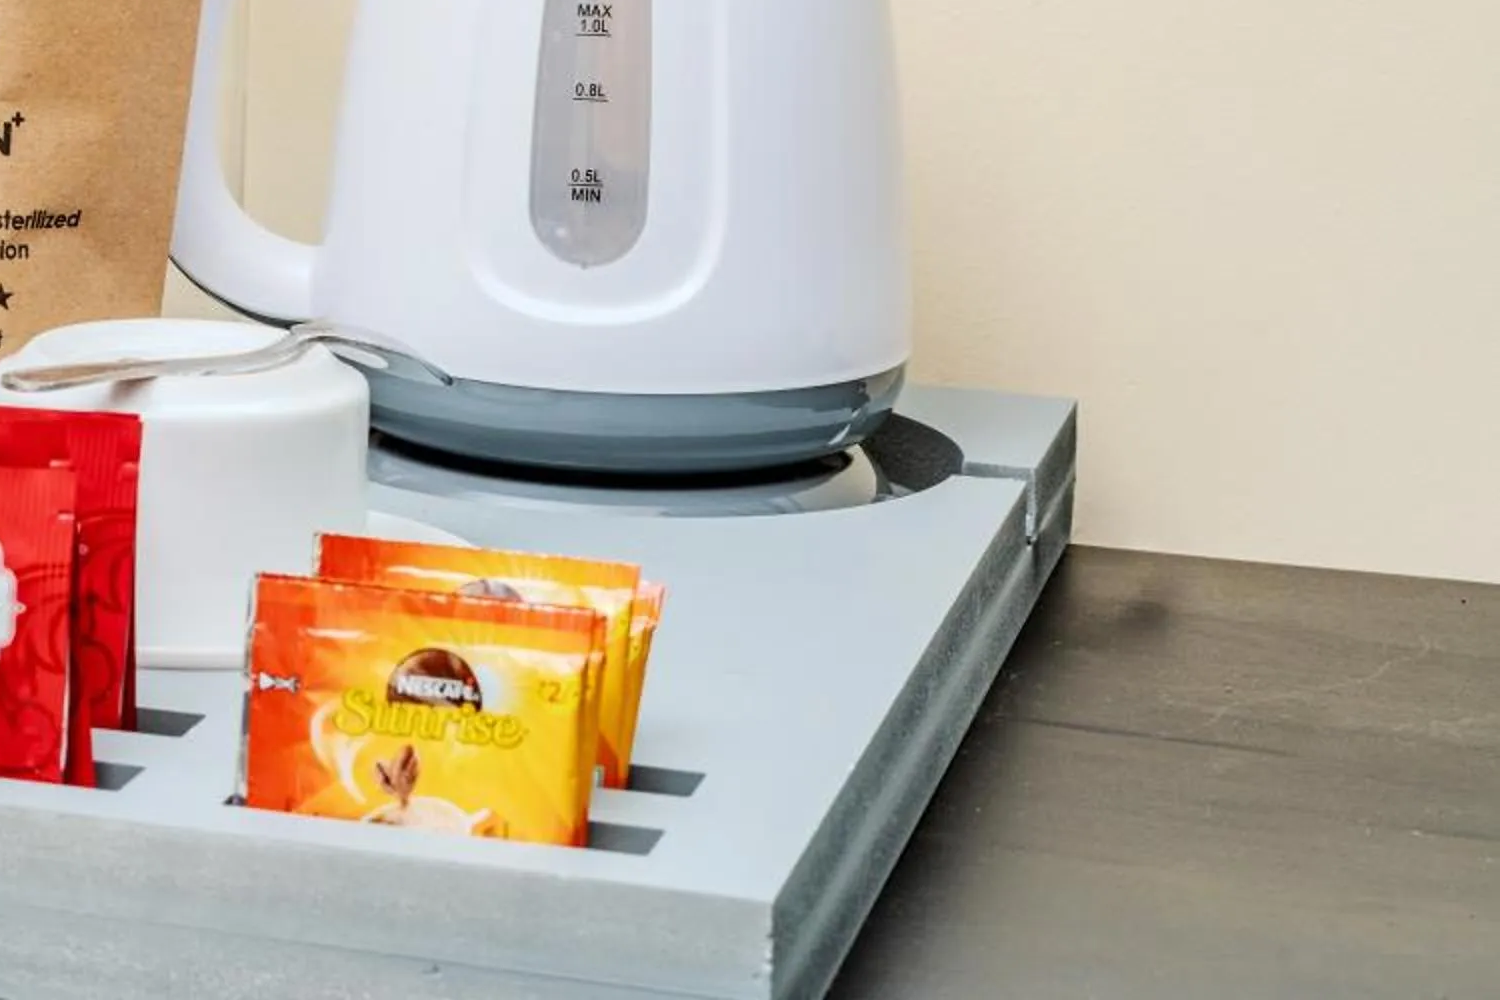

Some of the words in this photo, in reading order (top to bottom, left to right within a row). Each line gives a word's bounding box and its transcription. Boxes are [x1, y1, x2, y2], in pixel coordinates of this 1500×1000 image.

[577, 4, 612, 18] MAX
[581, 19, 609, 33] 1.0L
[575, 83, 605, 97] 0.8L
[571, 169, 602, 183] 0.5L
[571, 187, 602, 203] MIN
[333, 686, 522, 749] Sunrise
